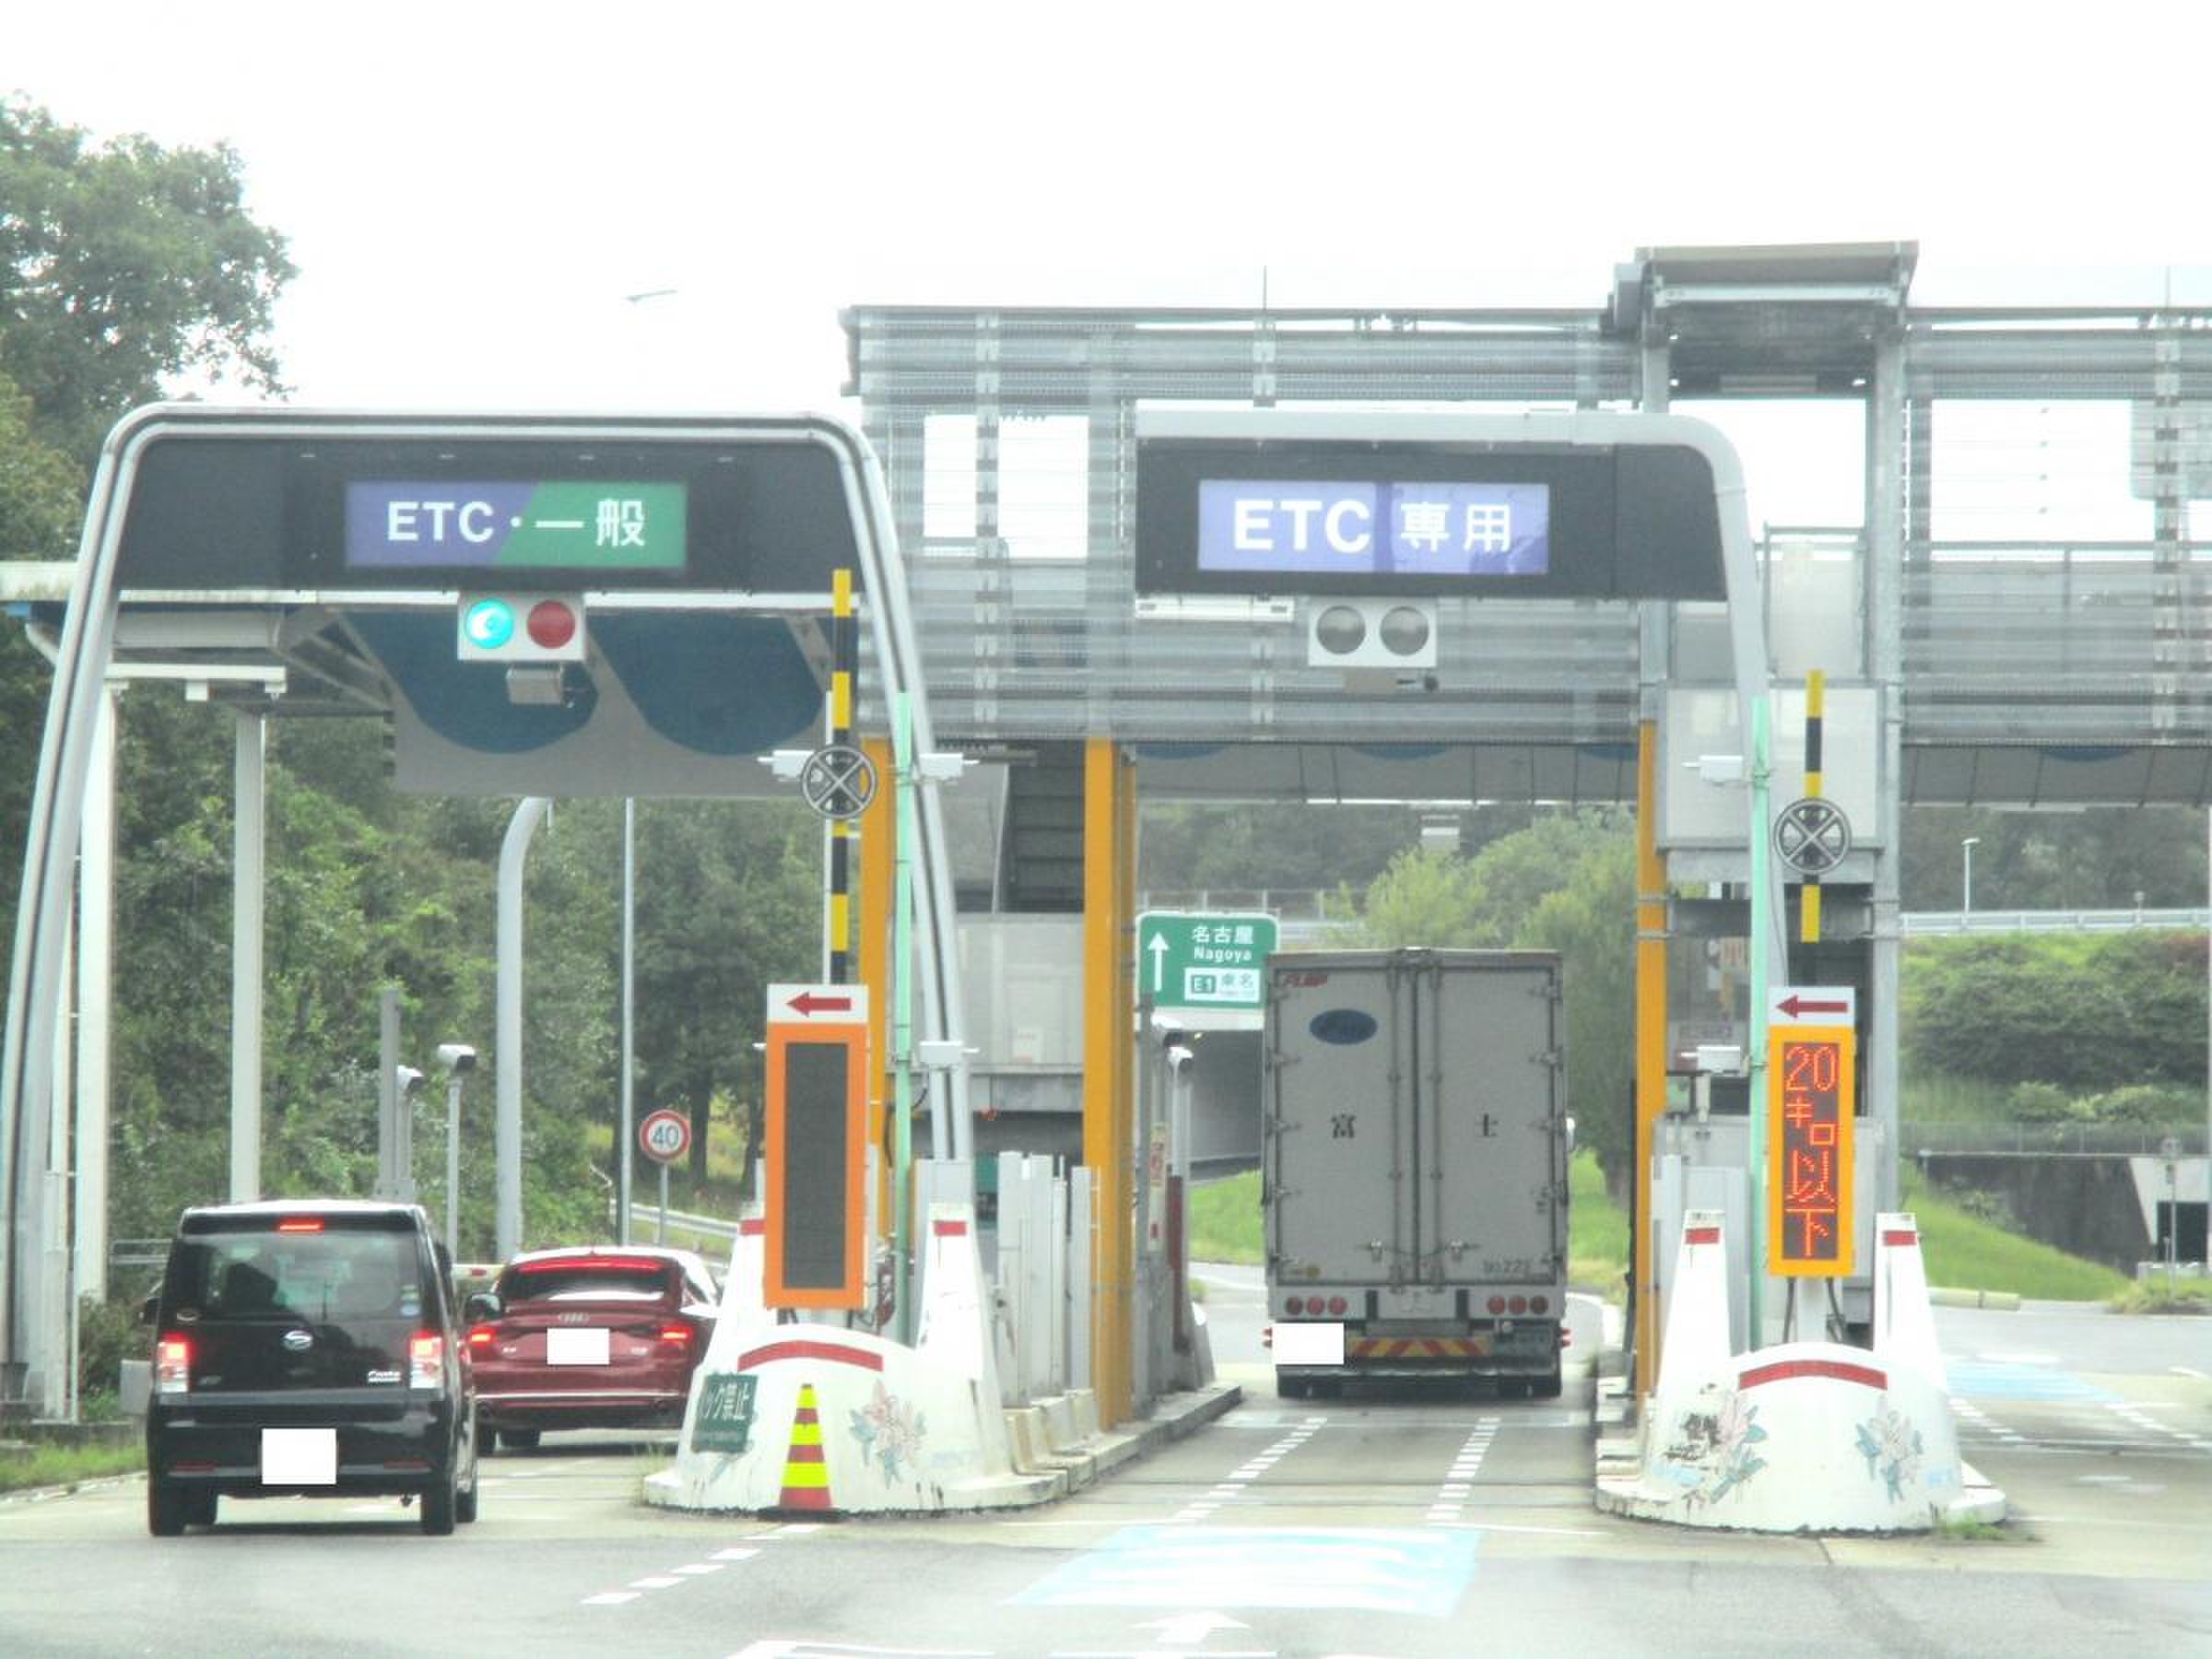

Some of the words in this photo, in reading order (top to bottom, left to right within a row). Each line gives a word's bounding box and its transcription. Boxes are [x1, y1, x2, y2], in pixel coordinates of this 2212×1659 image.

[1233, 499, 1371, 553] ETC
[1399, 500, 1512, 553] 専用
[1192, 925, 1253, 945] 名古屋
[1194, 946, 1253, 962] Nagoya
[653, 1124, 680, 1148] 40
